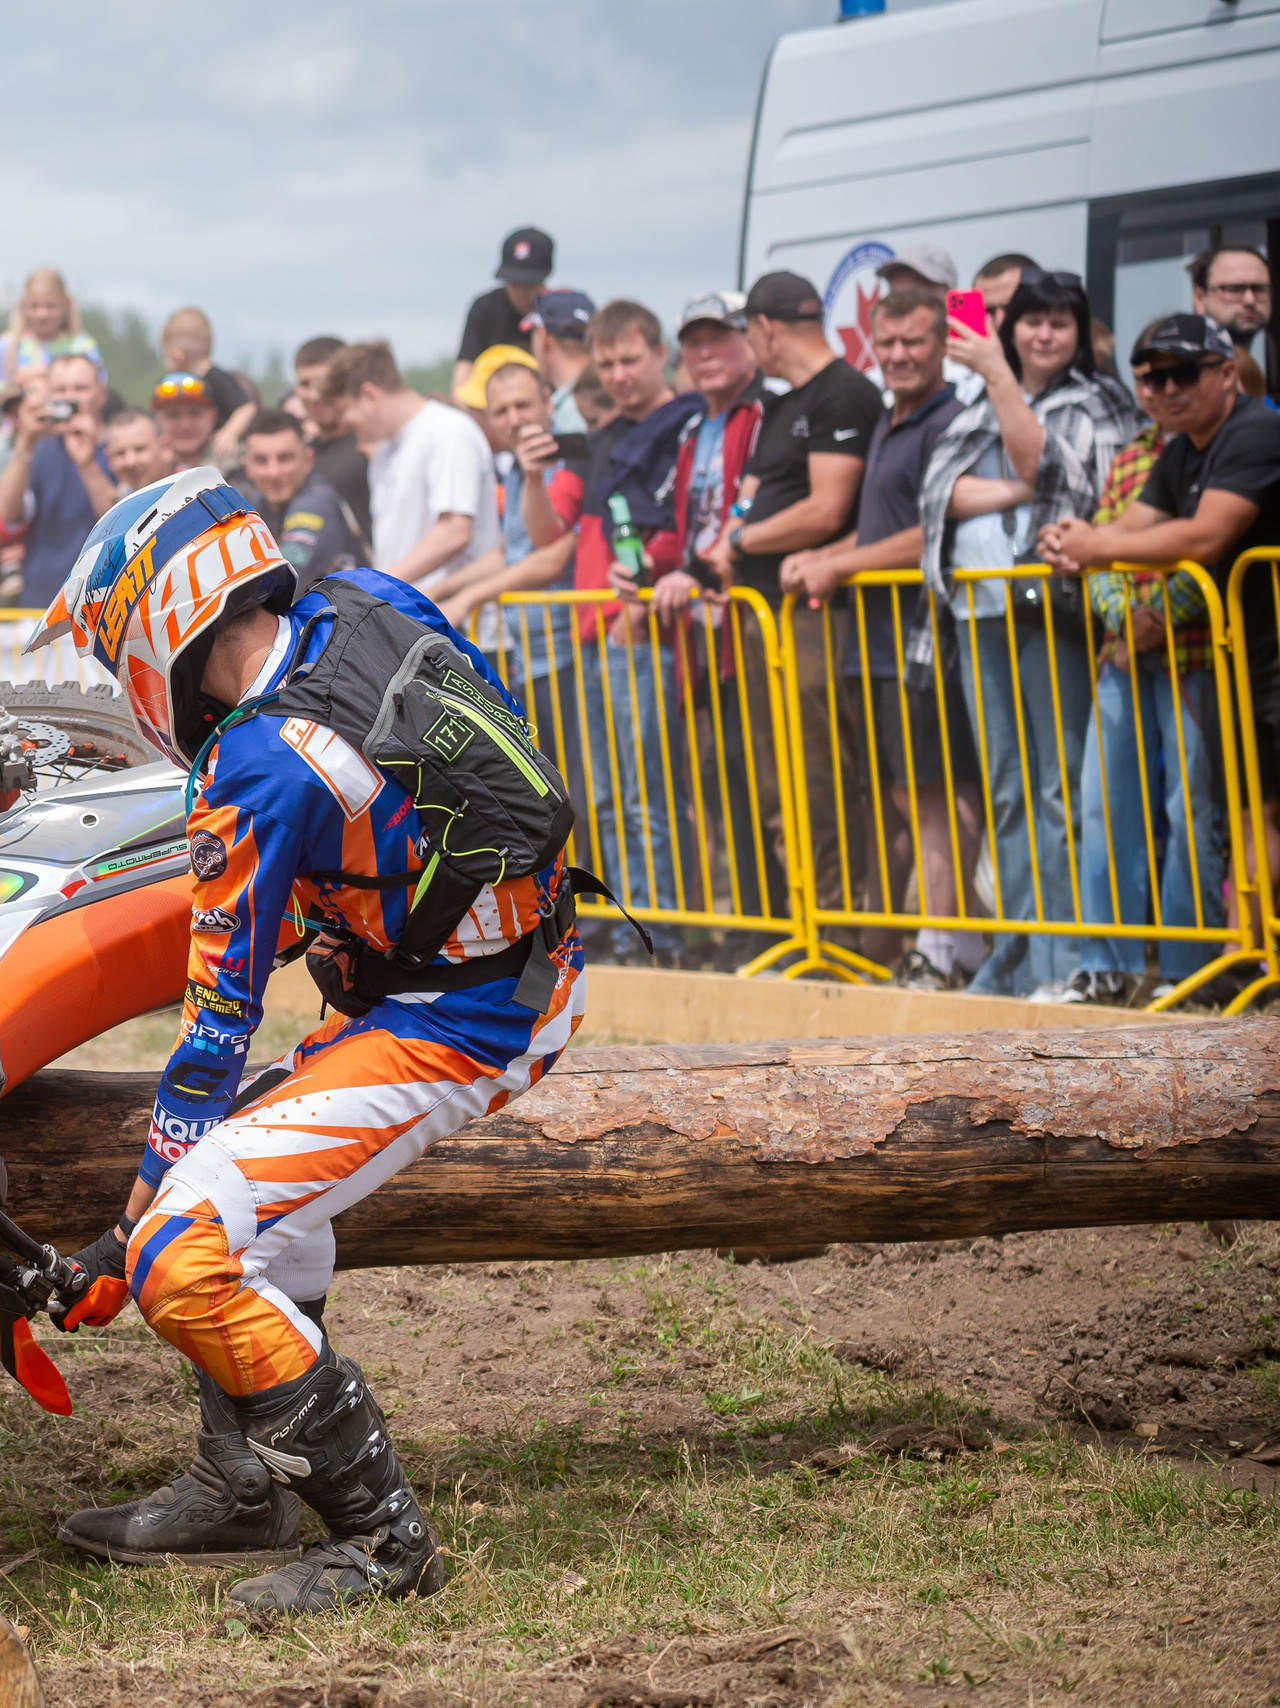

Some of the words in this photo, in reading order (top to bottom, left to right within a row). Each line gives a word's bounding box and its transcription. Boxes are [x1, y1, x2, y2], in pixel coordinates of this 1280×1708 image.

[98, 536, 157, 662] LEATT
[435, 717, 466, 750] 171
[107, 841, 188, 872] SUPERMOTO
[181, 1018, 248, 1044] oPro
